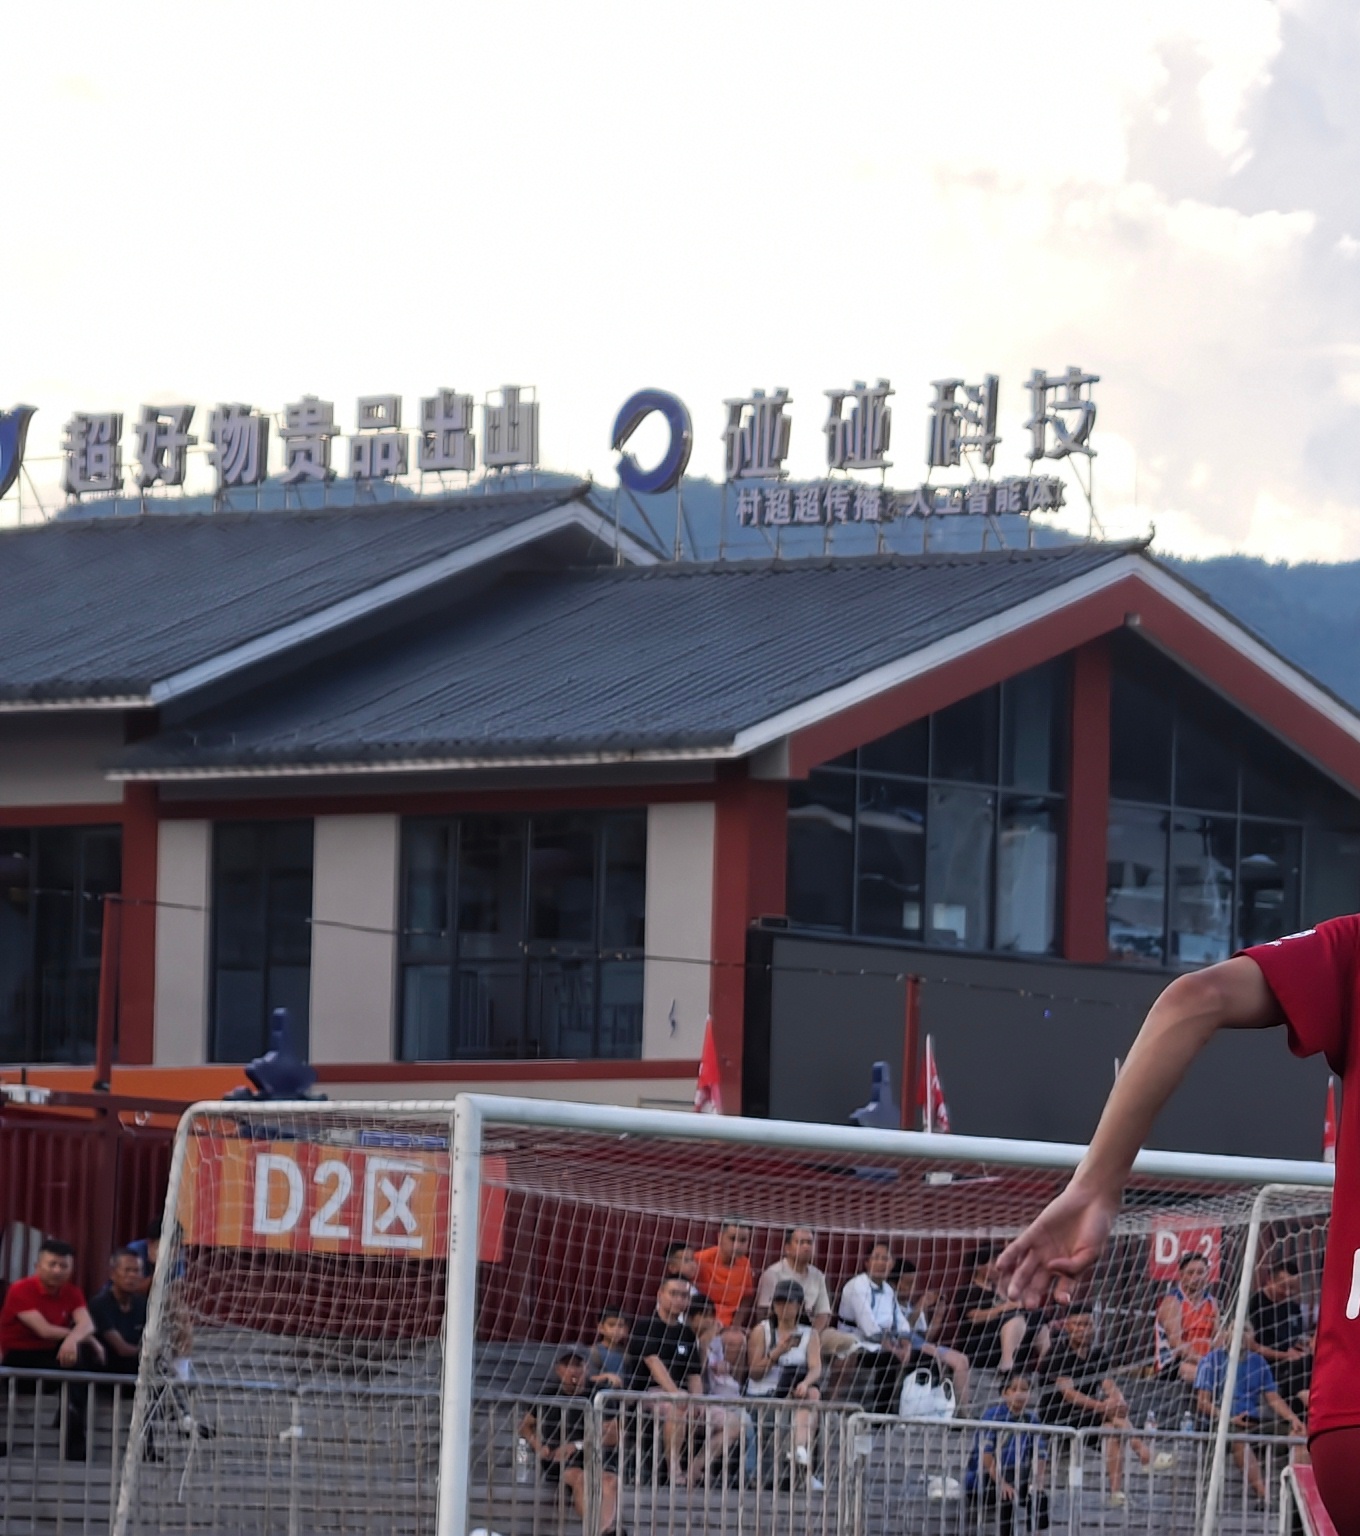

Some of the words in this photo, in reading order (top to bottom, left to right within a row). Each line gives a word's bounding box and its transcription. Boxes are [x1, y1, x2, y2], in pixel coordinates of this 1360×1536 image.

[61, 385, 540, 494] 超好物贵品出山
[722, 366, 1101, 478] 碰碰科技
[253, 1153, 425, 1250] D2区
